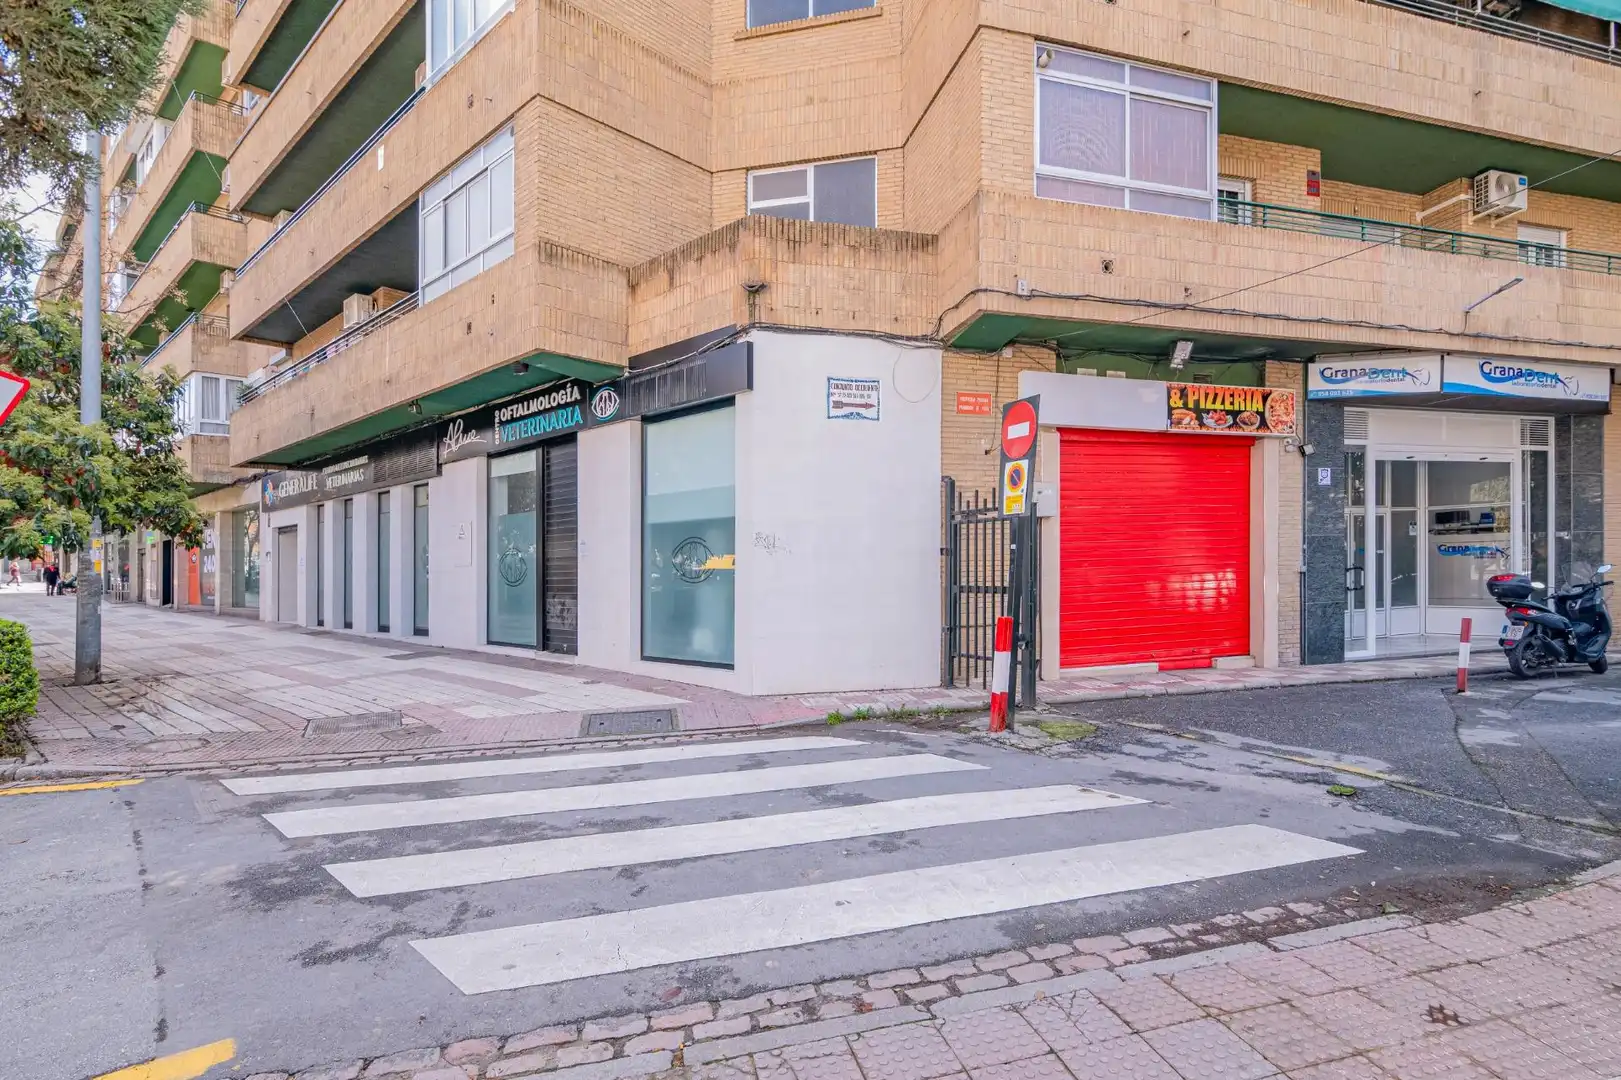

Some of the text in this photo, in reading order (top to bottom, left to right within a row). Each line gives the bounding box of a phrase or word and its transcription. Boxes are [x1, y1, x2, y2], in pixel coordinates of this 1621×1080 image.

[1321, 366, 1408, 380] GranaDent
[1481, 361, 1560, 384] GranaDent
[500, 383, 581, 422] OFTALMOLOGÍA
[1169, 384, 1264, 412] & PIZZERIA
[500, 405, 583, 443] VETERINARIA
[278, 472, 318, 498] GENERALIFE
[325, 468, 365, 490] VETERINARIAS
